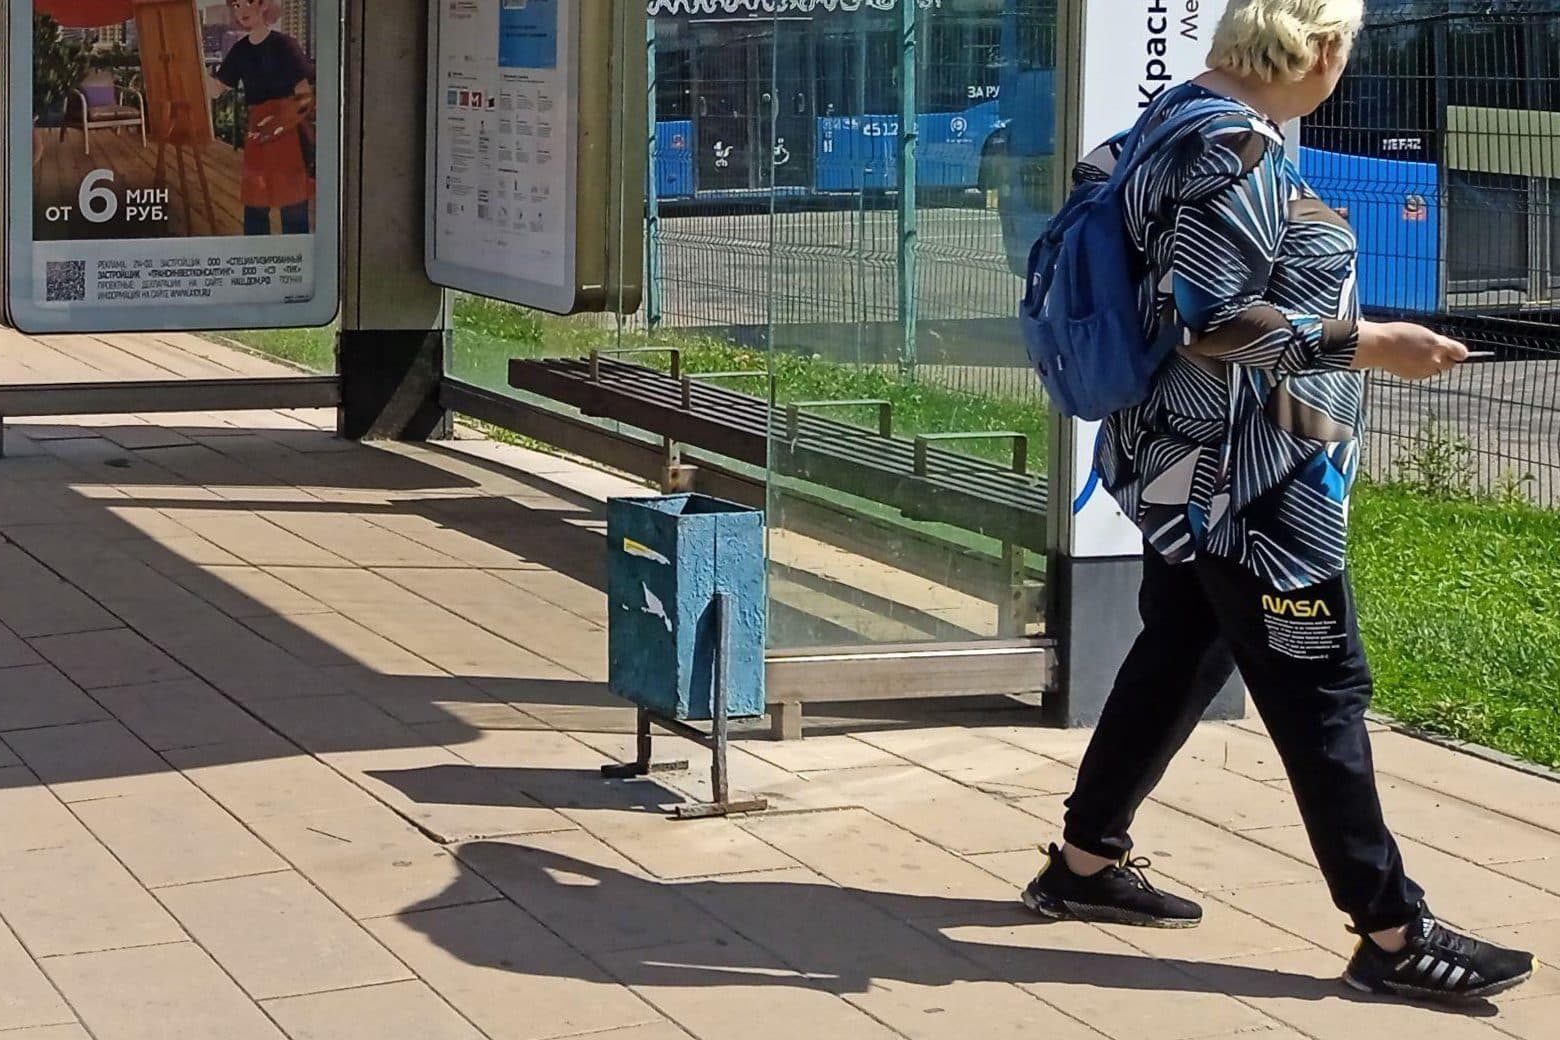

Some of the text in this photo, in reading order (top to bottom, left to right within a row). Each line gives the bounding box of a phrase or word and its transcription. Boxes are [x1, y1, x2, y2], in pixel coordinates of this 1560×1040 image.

[967, 86, 984, 99] ЗА
[44, 168, 169, 224] ОТ 6 МЛН
[126, 206, 169, 221] РУБ.
[1261, 594, 1331, 617] NASA
